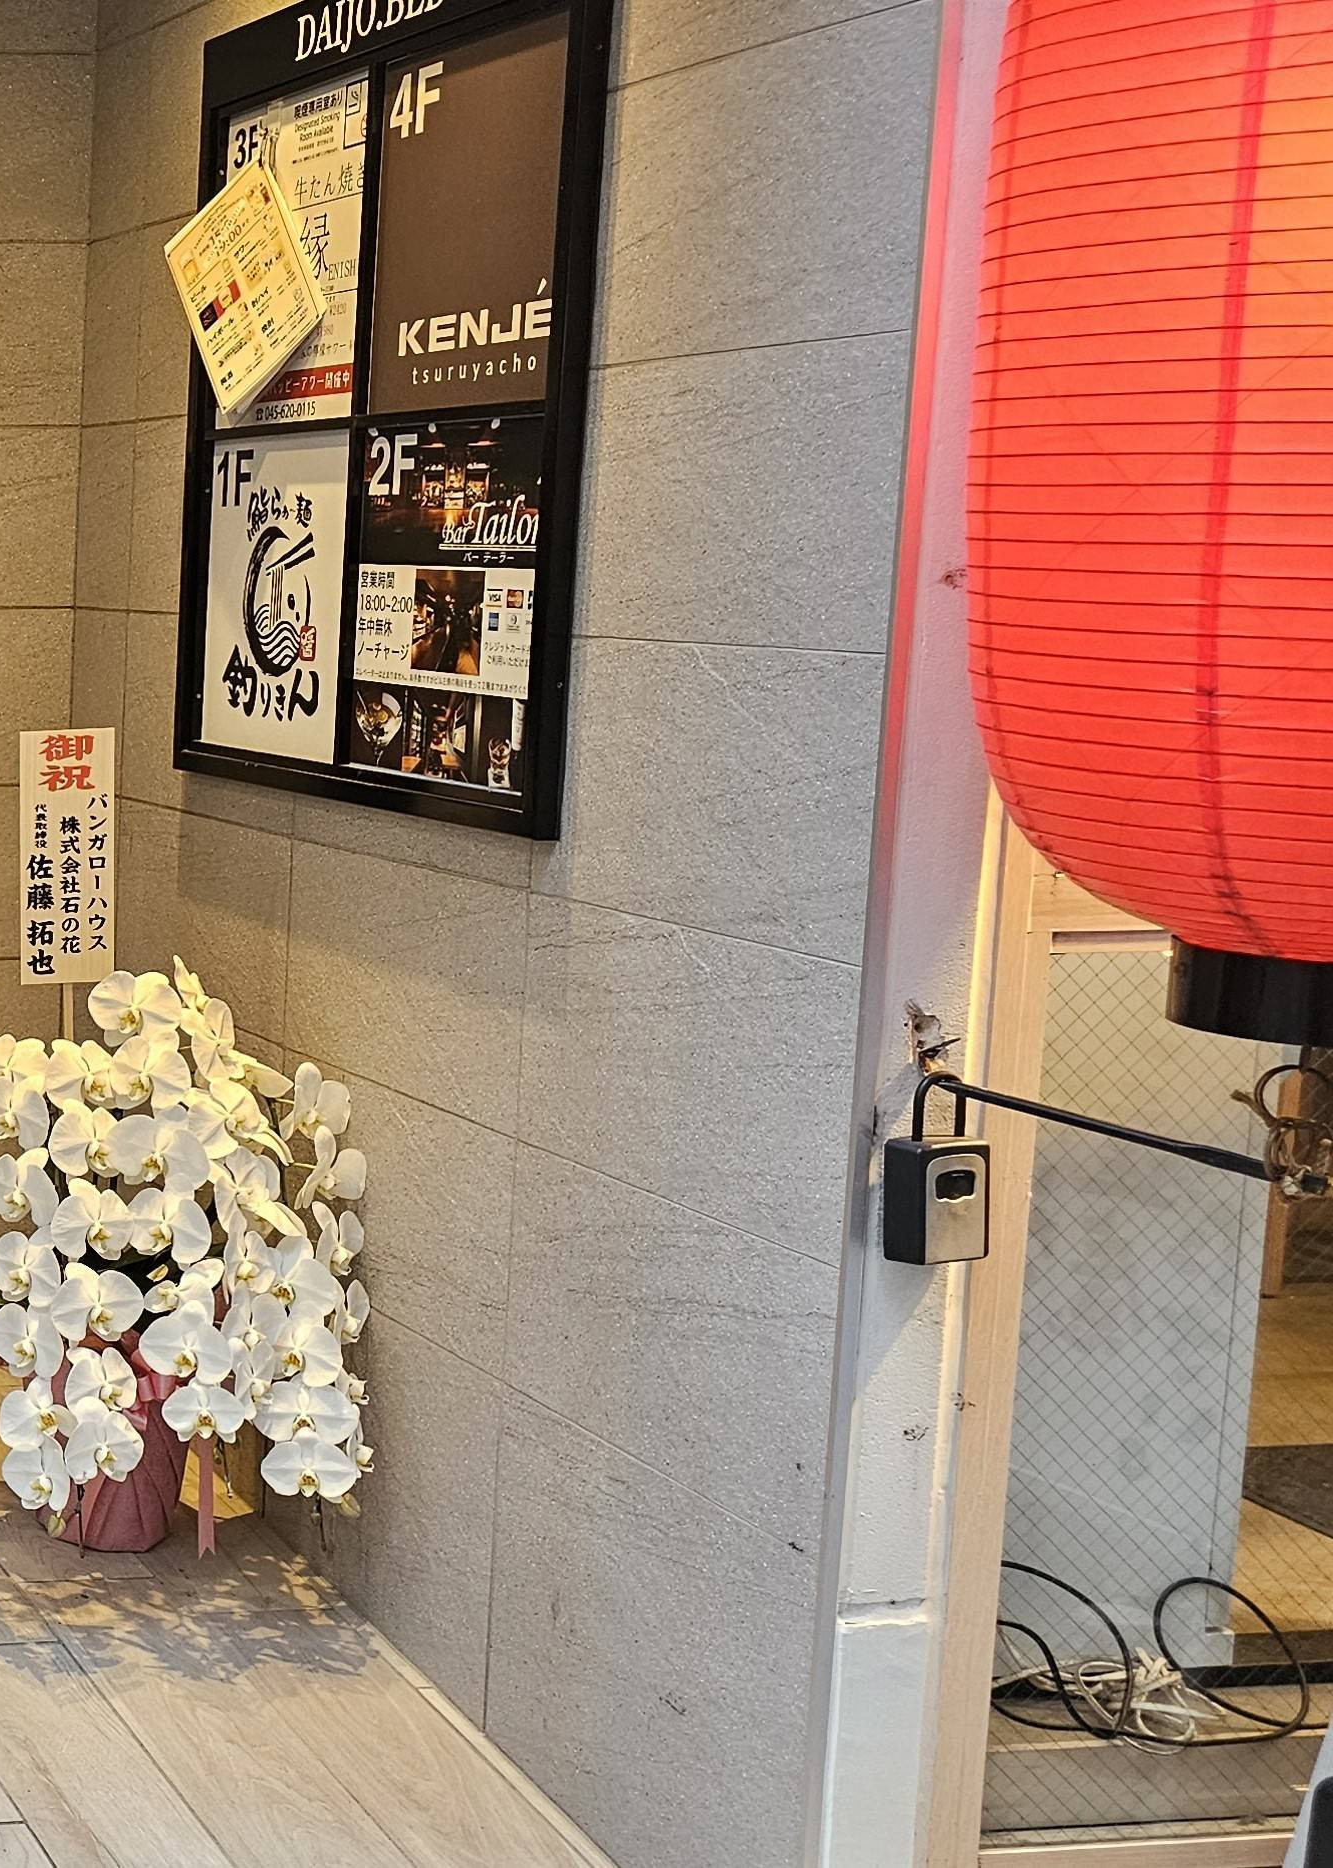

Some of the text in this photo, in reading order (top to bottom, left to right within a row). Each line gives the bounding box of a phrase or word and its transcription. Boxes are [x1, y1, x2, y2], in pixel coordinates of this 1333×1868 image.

[389, 61, 444, 139] 4F
[234, 124, 259, 169] 3F
[398, 278, 552, 356] KENJÉ
[412, 352, 537, 384] tsuruyacho
[265, 401, 316, 420] 045-620-0115
[217, 449, 254, 507] 1F
[368, 434, 417, 496] 2F
[442, 522, 475, 543] Bar
[360, 571, 395, 589] 営業時間
[360, 594, 412, 613] 18:00-2:00
[357, 641, 410, 661] ノーチャージ
[358, 618, 393, 636] 年中無休
[222, 644, 319, 722] 釣りきん
[38, 734, 95, 791] 御祝
[59, 816, 81, 954] 株式会社石の花
[87, 793, 109, 951] バンガローハウス
